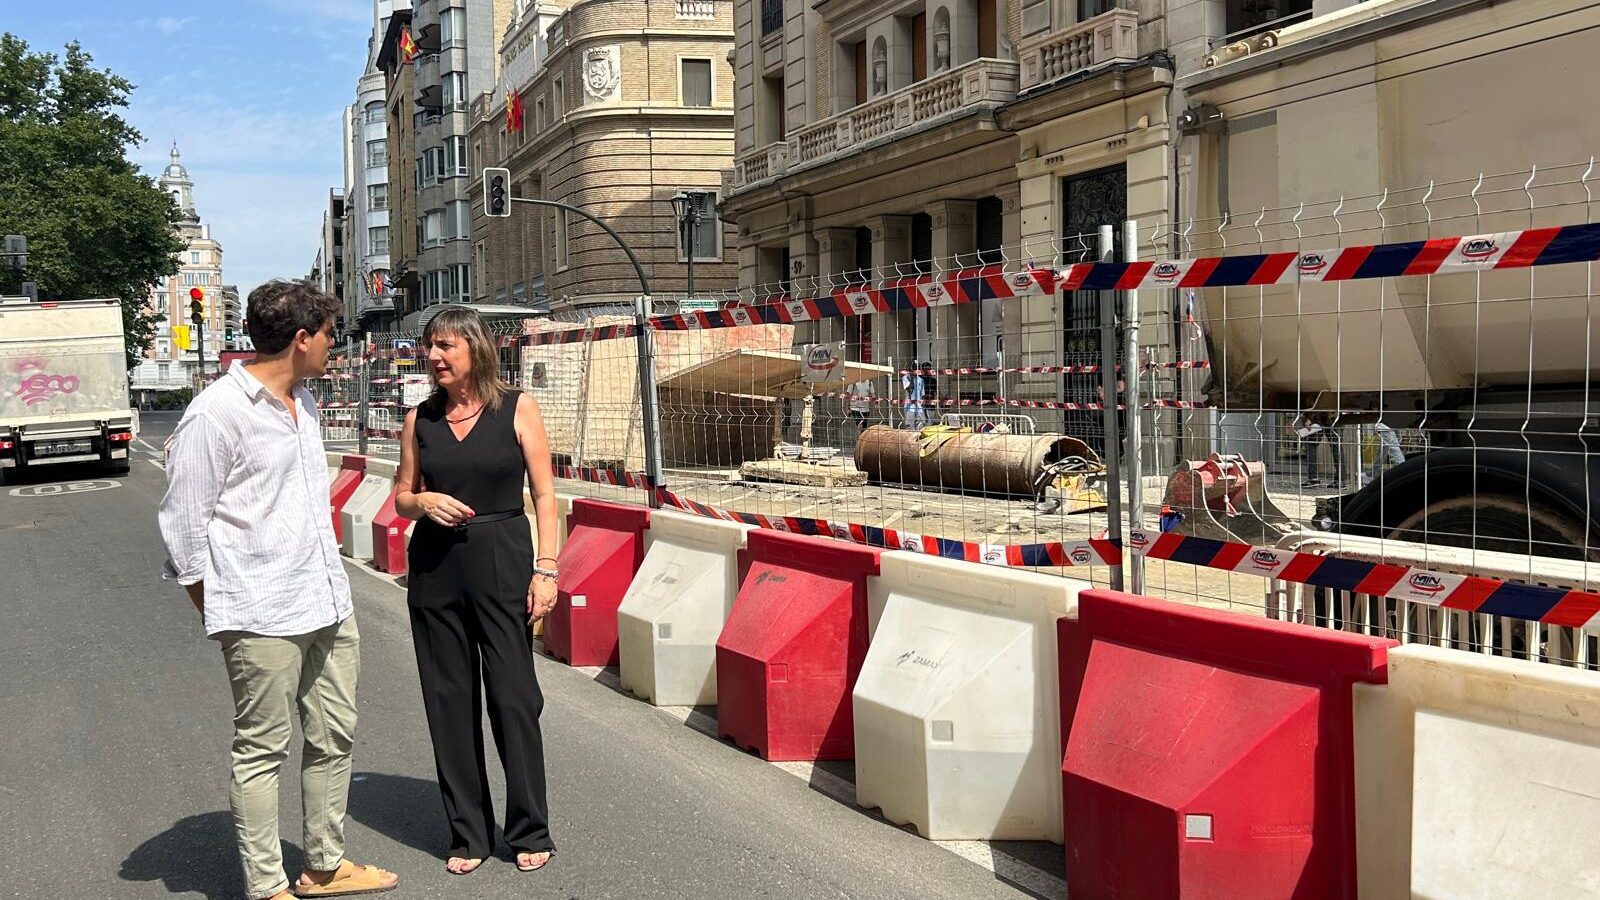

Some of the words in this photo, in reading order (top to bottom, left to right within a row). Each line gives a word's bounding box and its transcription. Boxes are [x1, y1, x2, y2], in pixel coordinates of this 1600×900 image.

[1467, 240, 1495, 251] MIN
[1302, 255, 1324, 265] MIN
[812, 349, 832, 360] MIN
[1255, 551, 1277, 562] MIN
[1413, 574, 1441, 586] MIN
